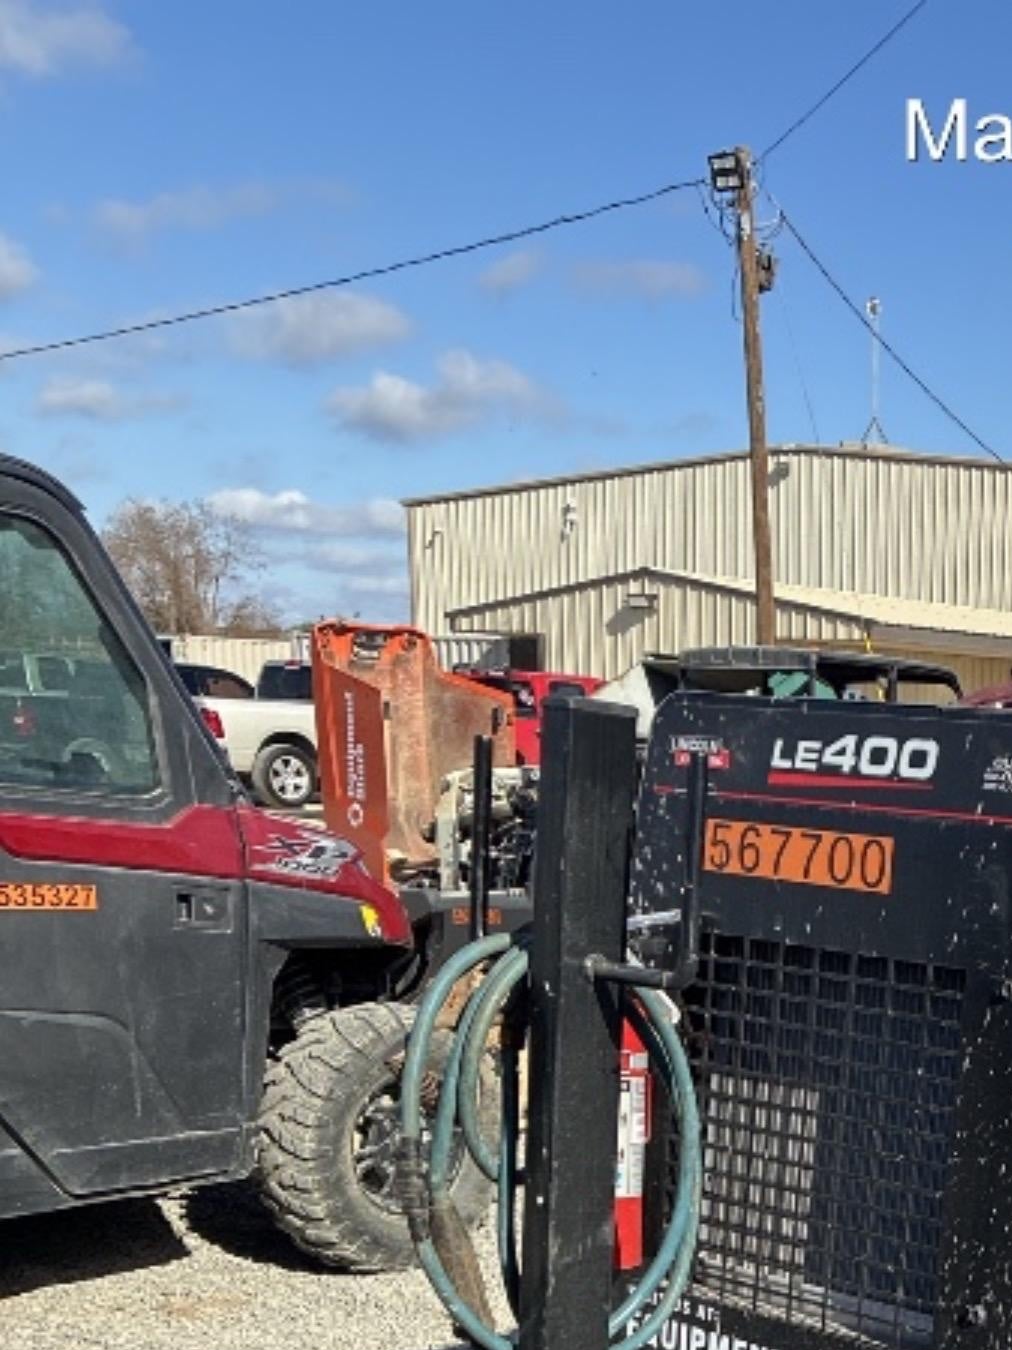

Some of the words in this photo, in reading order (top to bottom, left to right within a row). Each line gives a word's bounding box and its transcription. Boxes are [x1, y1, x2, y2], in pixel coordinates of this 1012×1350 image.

[769, 734, 940, 781] LE400
[709, 822, 887, 889] 567700
[0, 883, 94, 907] 535327
